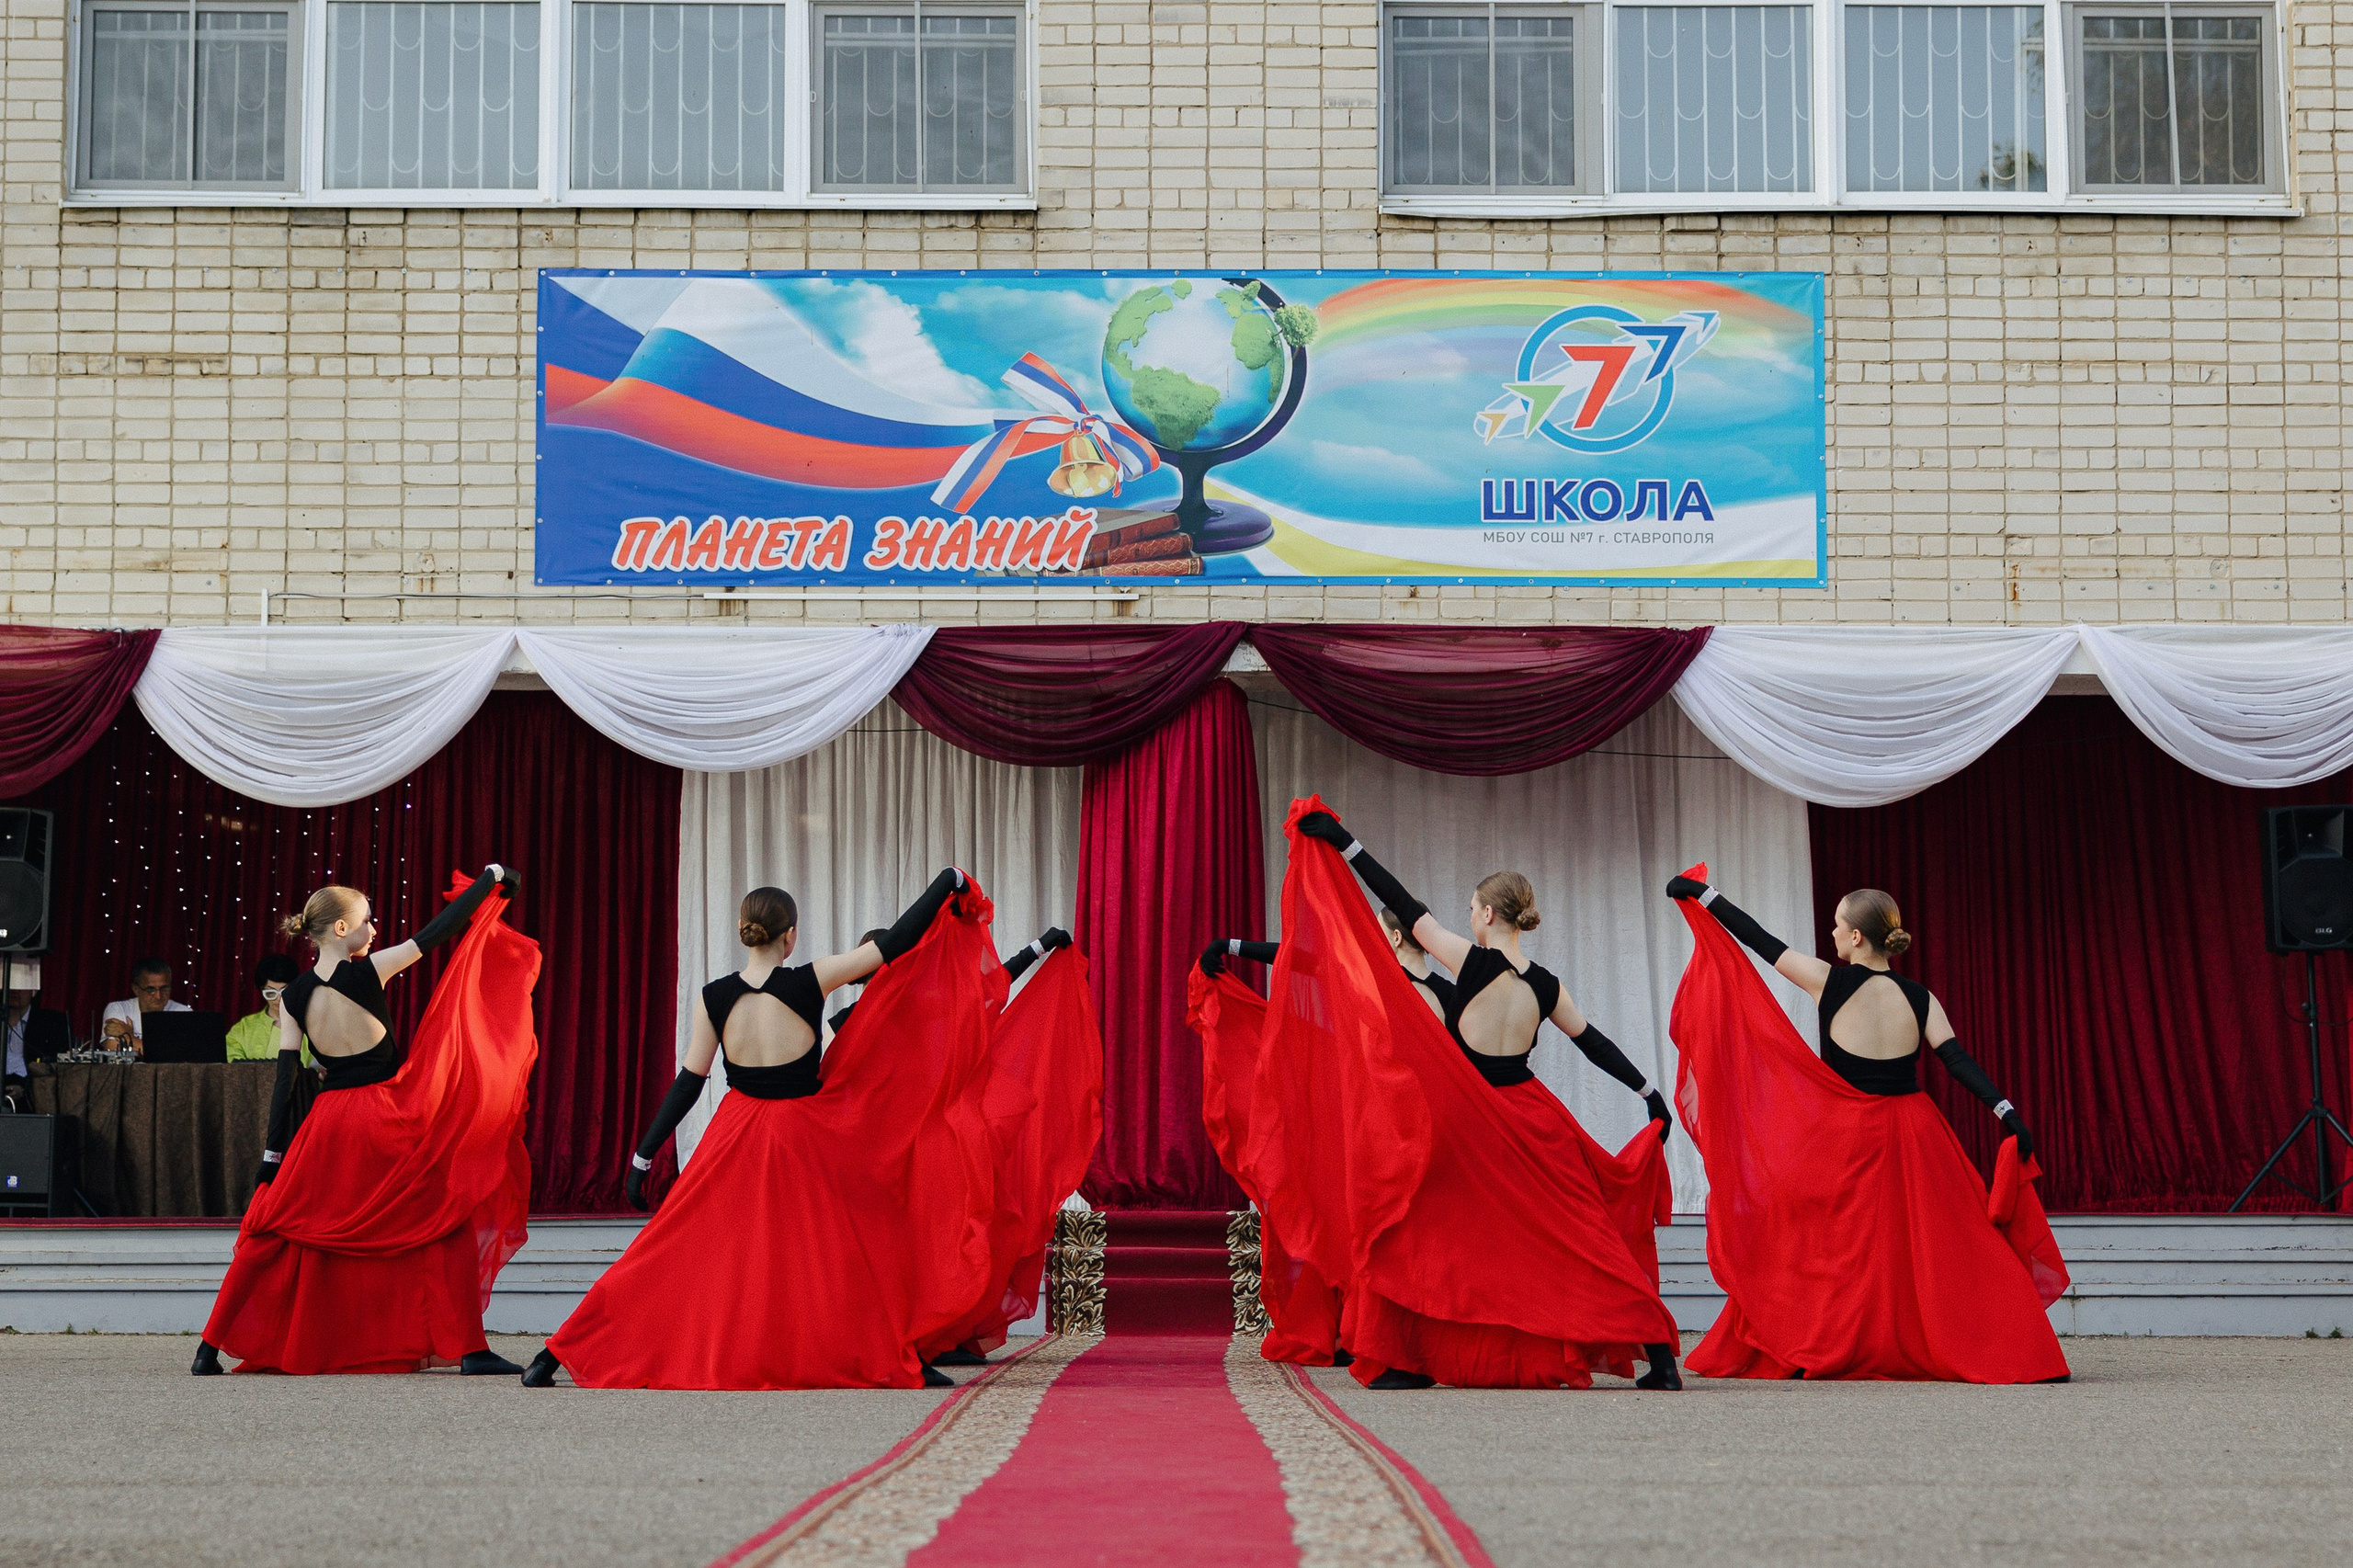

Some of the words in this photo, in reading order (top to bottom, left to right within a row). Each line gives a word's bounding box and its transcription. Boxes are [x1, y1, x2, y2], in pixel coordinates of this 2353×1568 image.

[1560, 344, 1638, 430] 7
[1482, 479, 1715, 522] ШКОЛА
[613, 516, 853, 572] ПЛАНЕТА
[864, 506, 1097, 572] ЗНАНИЙ
[1483, 531, 1526, 543] МБОУ
[1530, 531, 1564, 543] СОШ
[1570, 531, 1594, 543] №7
[1598, 534, 1608, 544] г.
[1613, 532, 1714, 544] СТАВРОПОЛЯ
